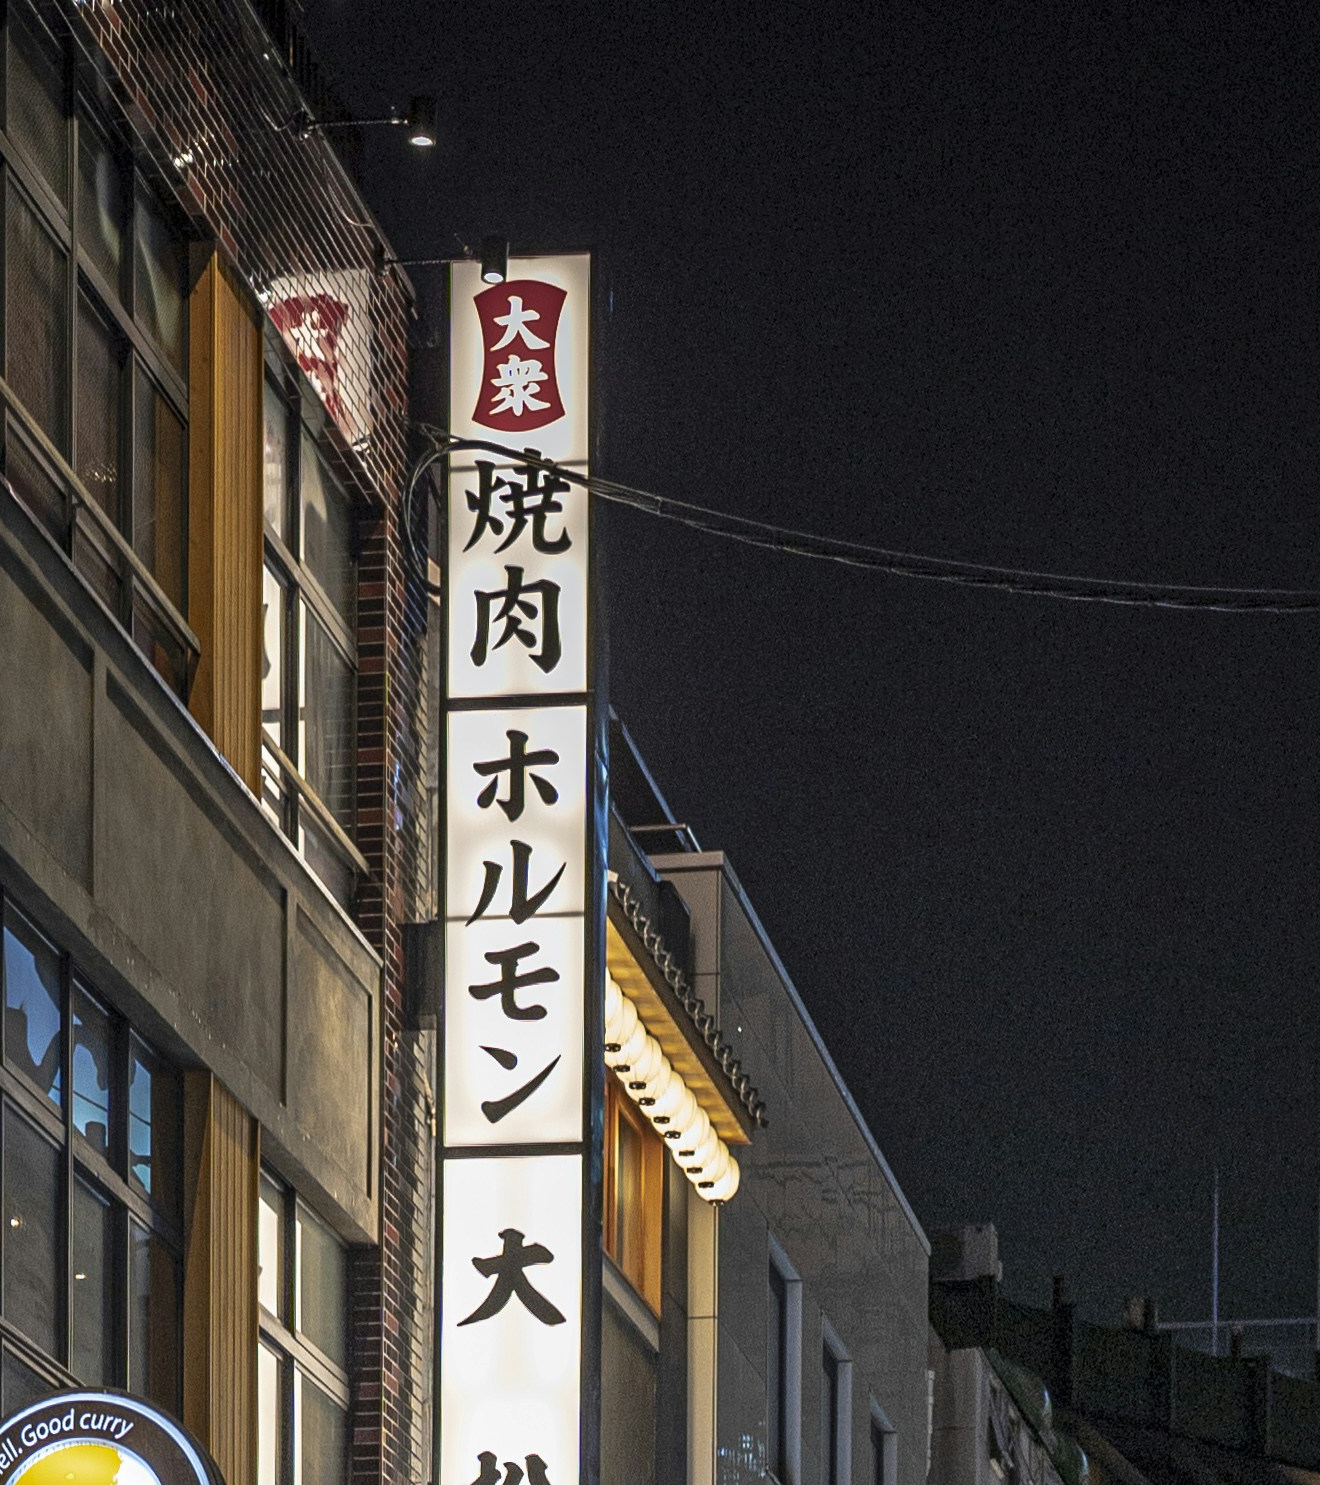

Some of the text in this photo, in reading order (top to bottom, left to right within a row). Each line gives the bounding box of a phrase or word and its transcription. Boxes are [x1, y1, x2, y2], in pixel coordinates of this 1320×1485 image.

[489, 293, 550, 415] 大衆
[463, 446, 572, 676] 焼肉
[466, 729, 568, 1124] ホルモン
[20, 1408, 76, 1448] Good
[79, 1410, 134, 1440] curry
